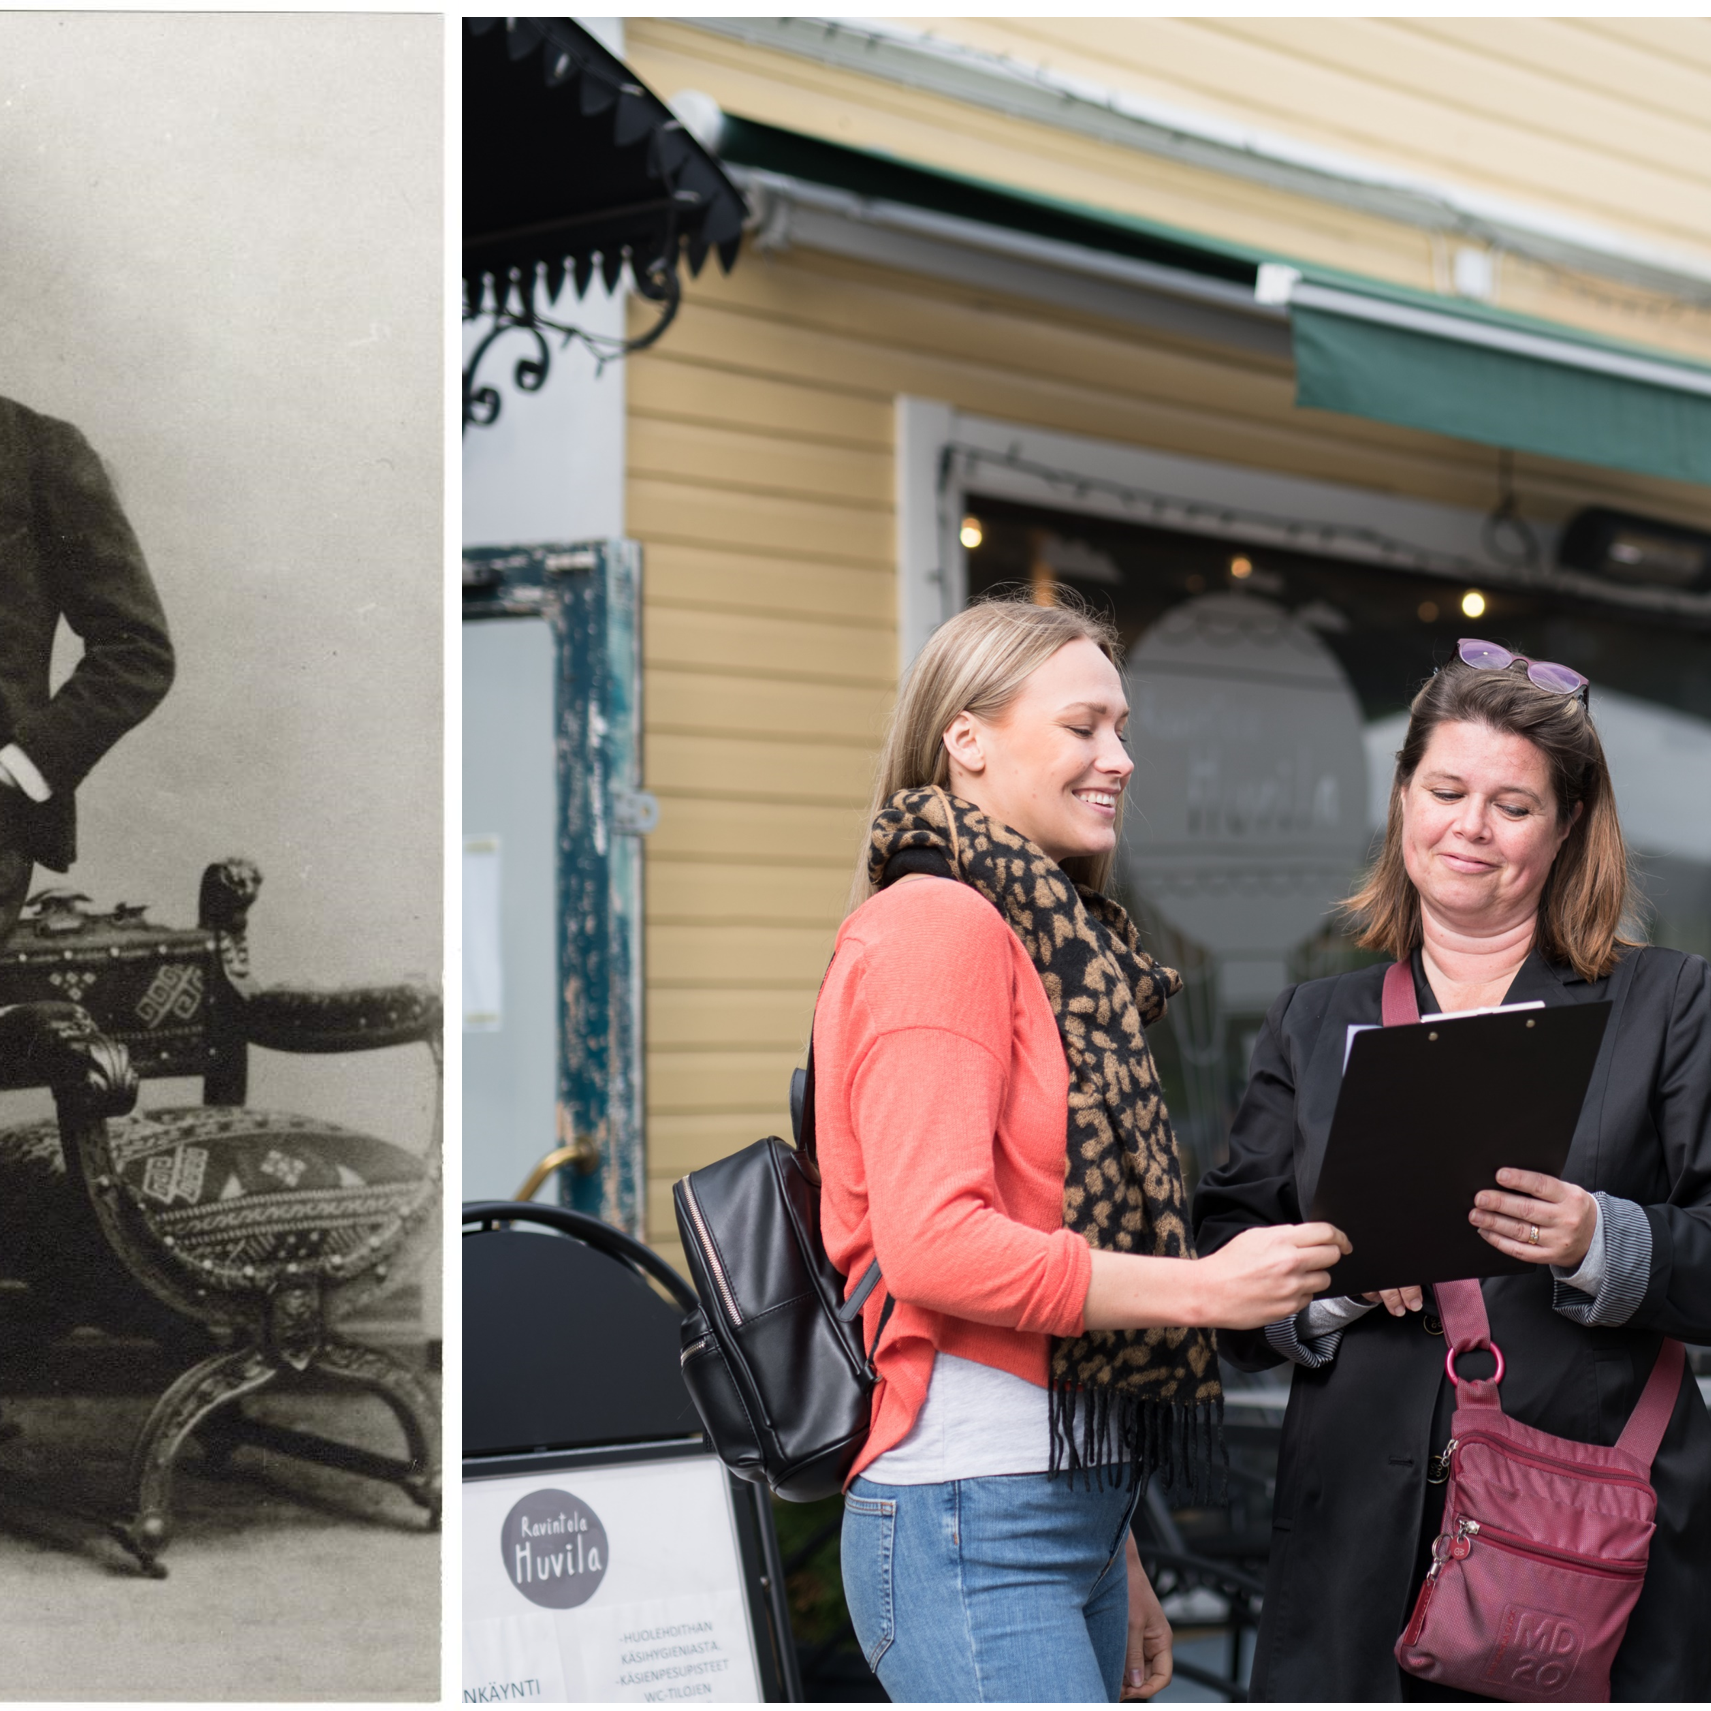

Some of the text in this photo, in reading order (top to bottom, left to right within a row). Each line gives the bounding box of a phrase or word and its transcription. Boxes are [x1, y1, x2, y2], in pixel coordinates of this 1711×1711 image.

[521, 1510, 588, 1538] Ravintola
[515, 1533, 602, 1584] Huvila
[1514, 1612, 1576, 1655] MD
[1511, 1655, 1566, 1687] 20
[643, 1683, 712, 1703] WC-TILOJEN
